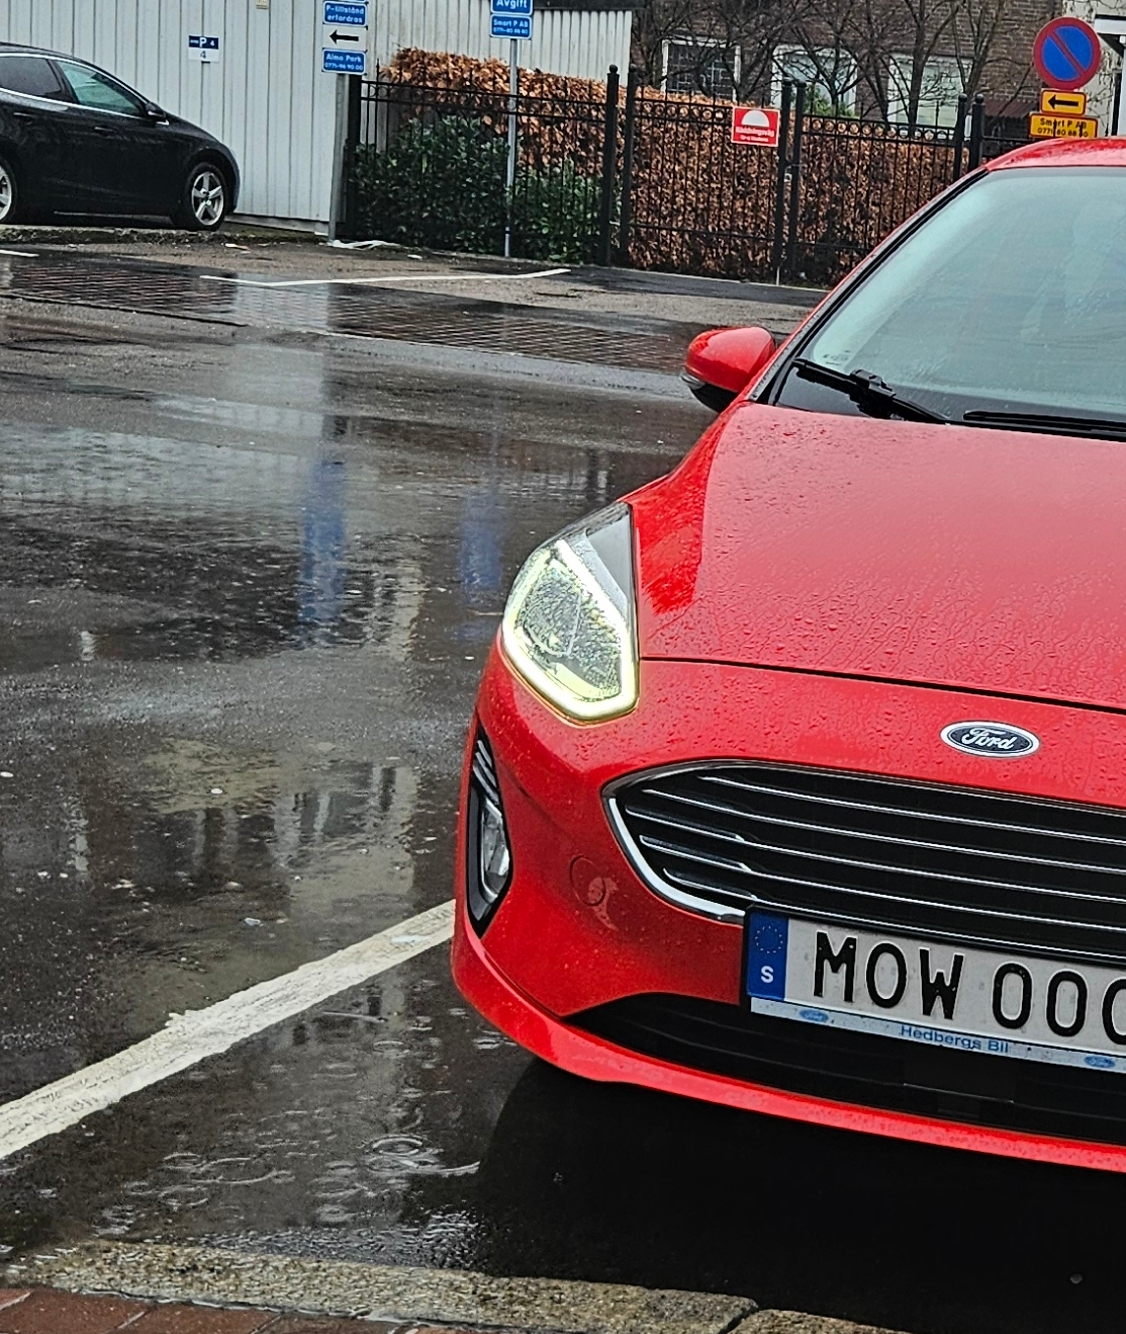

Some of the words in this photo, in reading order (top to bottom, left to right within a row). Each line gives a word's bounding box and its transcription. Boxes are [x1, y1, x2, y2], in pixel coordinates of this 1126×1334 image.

[493, 18, 512, 27] Smart
[513, 19, 518, 27] P
[519, 20, 529, 28] AB
[345, 54, 362, 63] Park
[1040, 117, 1065, 127] Smrt
[1067, 120, 1073, 128] P
[960, 727, 1018, 750] Ford
[760, 965, 774, 984] S
[813, 931, 964, 1020] MOW
[900, 1025, 982, 1050] Hedbergs
[987, 1040, 1009, 1053] Bil
